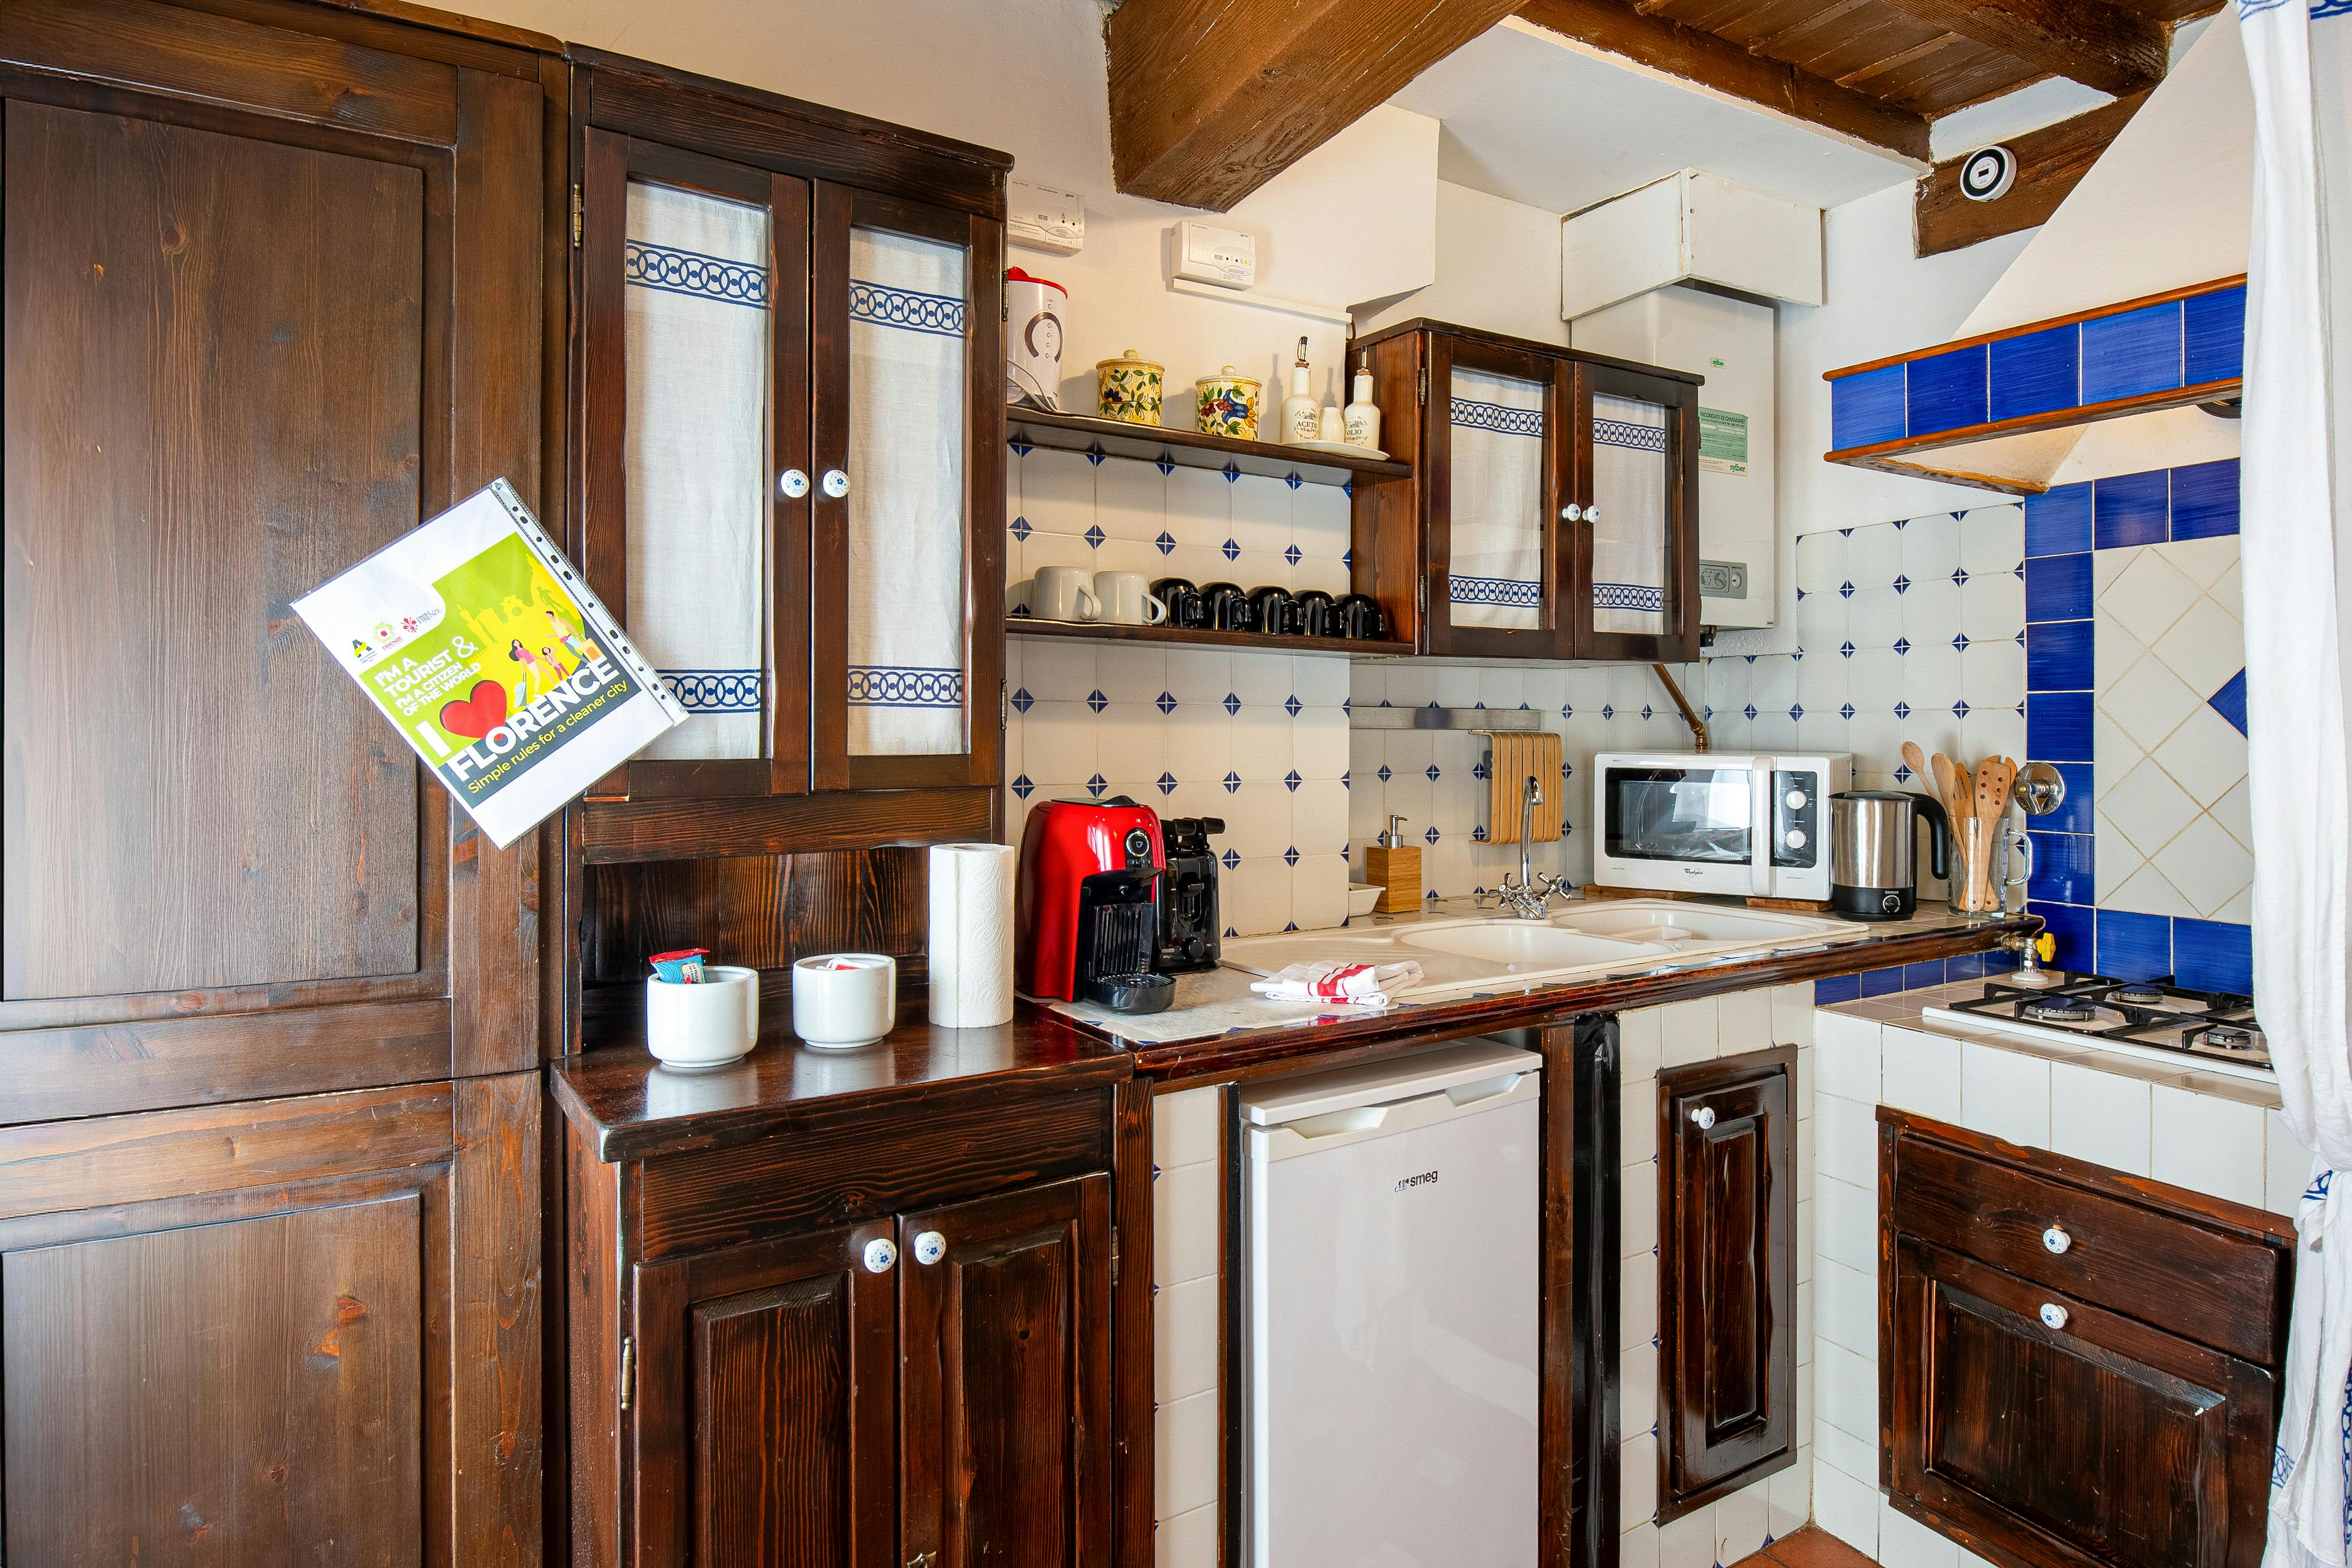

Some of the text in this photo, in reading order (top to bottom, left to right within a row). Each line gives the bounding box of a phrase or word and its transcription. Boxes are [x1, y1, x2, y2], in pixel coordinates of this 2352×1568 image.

[1297, 421, 1317, 429] ACETO
[1730, 464, 1746, 472] sylber
[382, 636, 403, 650] FIRENZE
[374, 664, 403, 687] I'M
[401, 657, 418, 672] A
[384, 635, 479, 698] TOURIST &
[395, 661, 463, 709] I'M A CITIZEN
[403, 662, 482, 716] OF THE WORLD
[446, 655, 620, 782] FLORENCE
[416, 720, 451, 759] I
[468, 680, 628, 794] Simple rules for a cleaner city
[1685, 867, 1704, 878] Whirlpool
[1410, 1171, 1438, 1187] smeg
